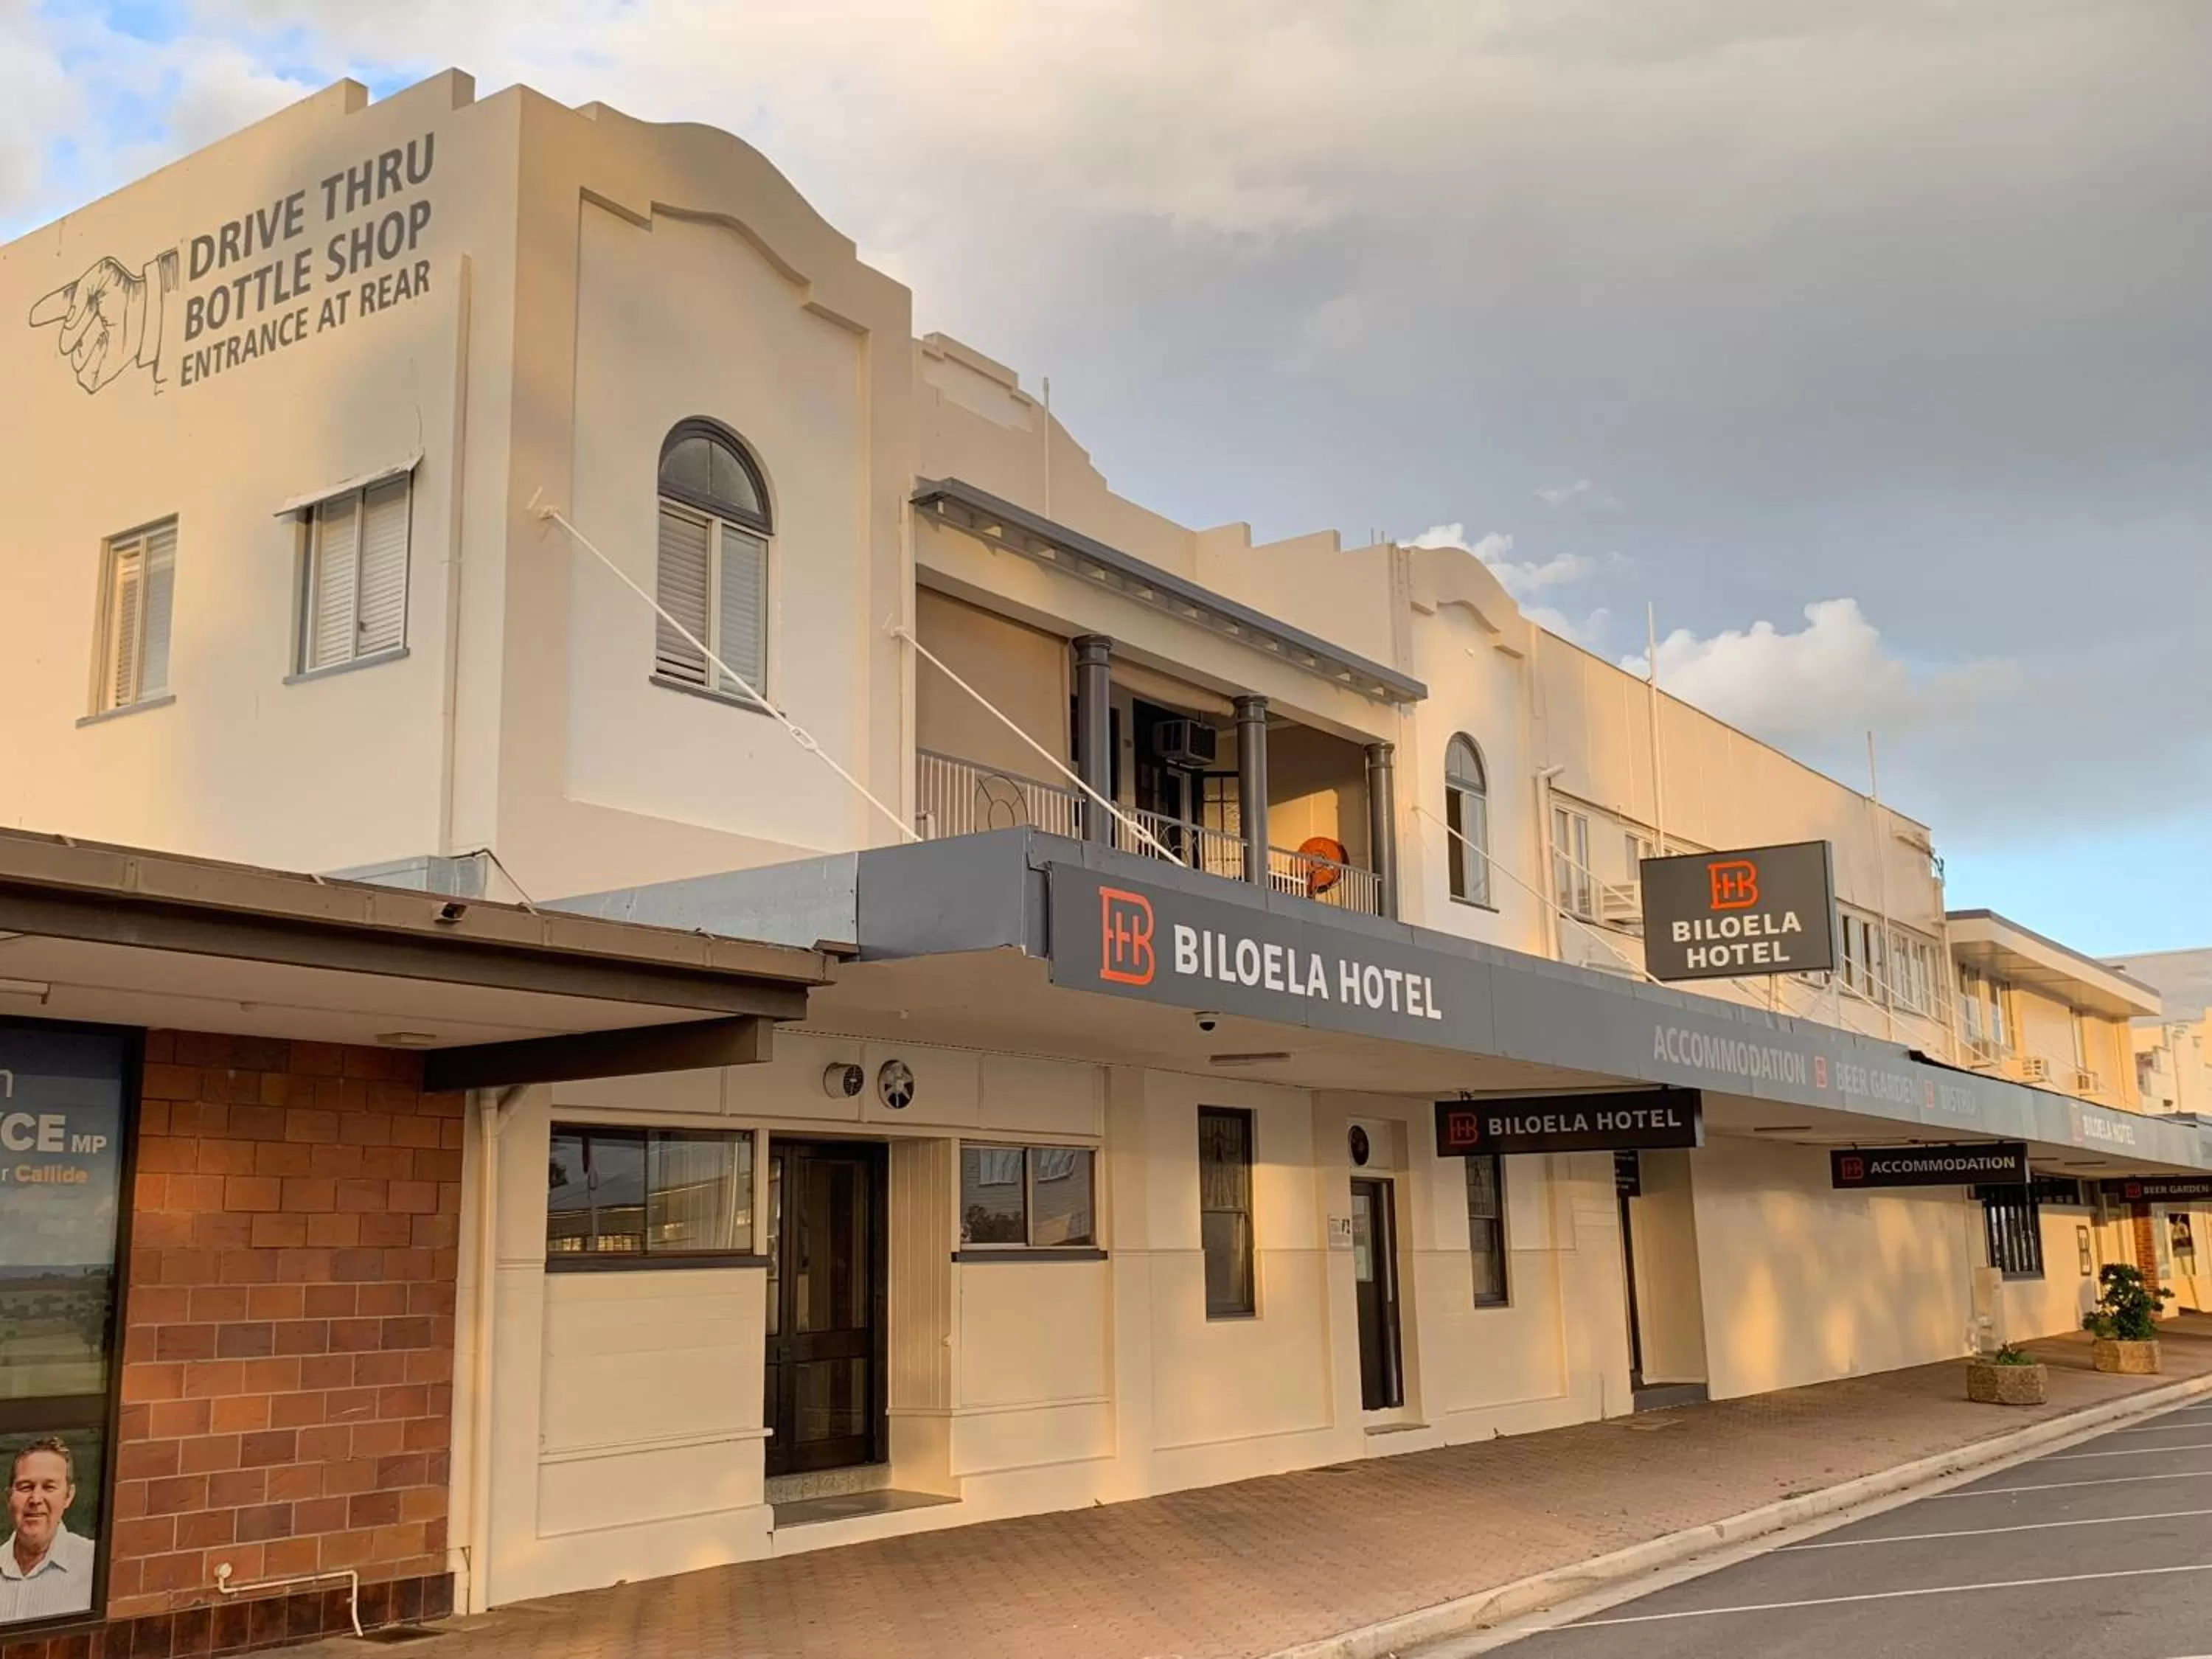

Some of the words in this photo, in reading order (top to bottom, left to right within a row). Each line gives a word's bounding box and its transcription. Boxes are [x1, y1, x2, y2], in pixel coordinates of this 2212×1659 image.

[188, 189, 305, 282] DRIVE
[320, 132, 435, 221] THRU
[184, 247, 313, 343] BOTTLE
[324, 199, 432, 282] SHOP
[180, 307, 309, 387] ENTRANCE
[316, 290, 350, 333] AT
[358, 260, 431, 318] REAR
[1672, 911, 1802, 942] BILOELA
[1174, 924, 1329, 1000] BILOELA
[1339, 959, 1443, 1020] HOTEL
[1686, 941, 1791, 969] HOTEL
[1654, 1024, 1806, 1085] ACCOMMODATION
[0, 1111, 66, 1152] CE
[71, 1134, 107, 1154] MP
[1488, 1113, 1589, 1136] BILOELA
[1596, 1108, 1683, 1130] HOTEL
[1870, 1155, 2016, 1175] ACCOMMODATION
